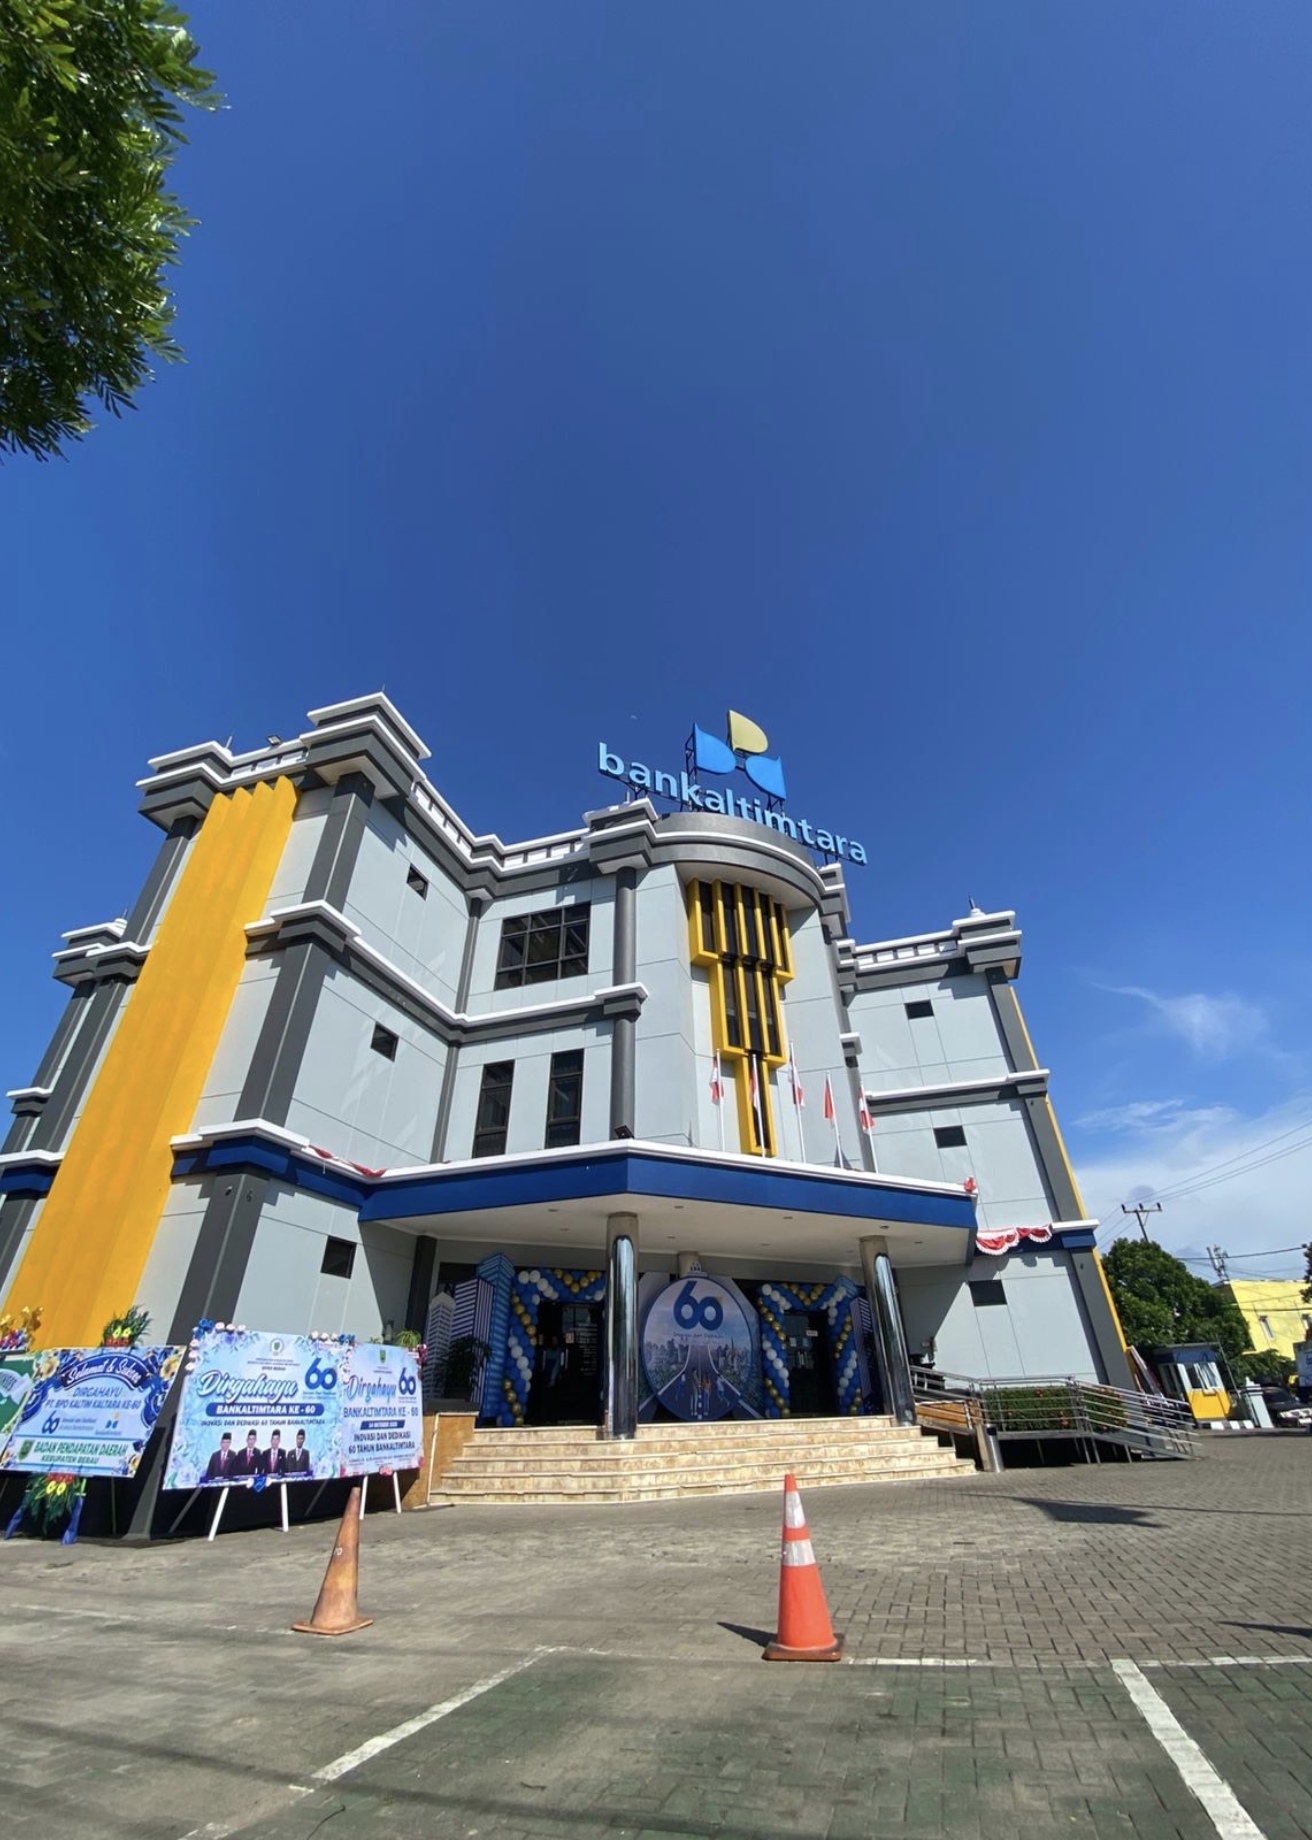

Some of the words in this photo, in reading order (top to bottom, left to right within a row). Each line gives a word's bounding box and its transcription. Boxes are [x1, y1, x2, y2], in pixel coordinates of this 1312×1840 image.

[598, 741, 867, 865] bankaltimtara
[673, 1280, 723, 1331] 60
[197, 1370, 298, 1404] Dirgahayu
[304, 1357, 337, 1390] 60
[398, 1367, 417, 1396] 60
[343, 1374, 397, 1404] Dirgahayu
[42, 1410, 60, 1434] 60
[216, 1405, 287, 1416] BANKALTIMTARA
[288, 1406, 300, 1415] KE
[305, 1405, 316, 1415] 60
[343, 1406, 397, 1418] BANKALTIMTARA
[399, 1406, 407, 1417] KE
[411, 1406, 419, 1417] 60
[348, 1444, 357, 1454] 60
[357, 1443, 375, 1453] TAHUN
[376, 1441, 416, 1452] BANKALTIMTARA
[354, 1432, 376, 1442] INOVASI
[377, 1431, 388, 1441] DAN
[388, 1431, 412, 1440] DEDIKASI
